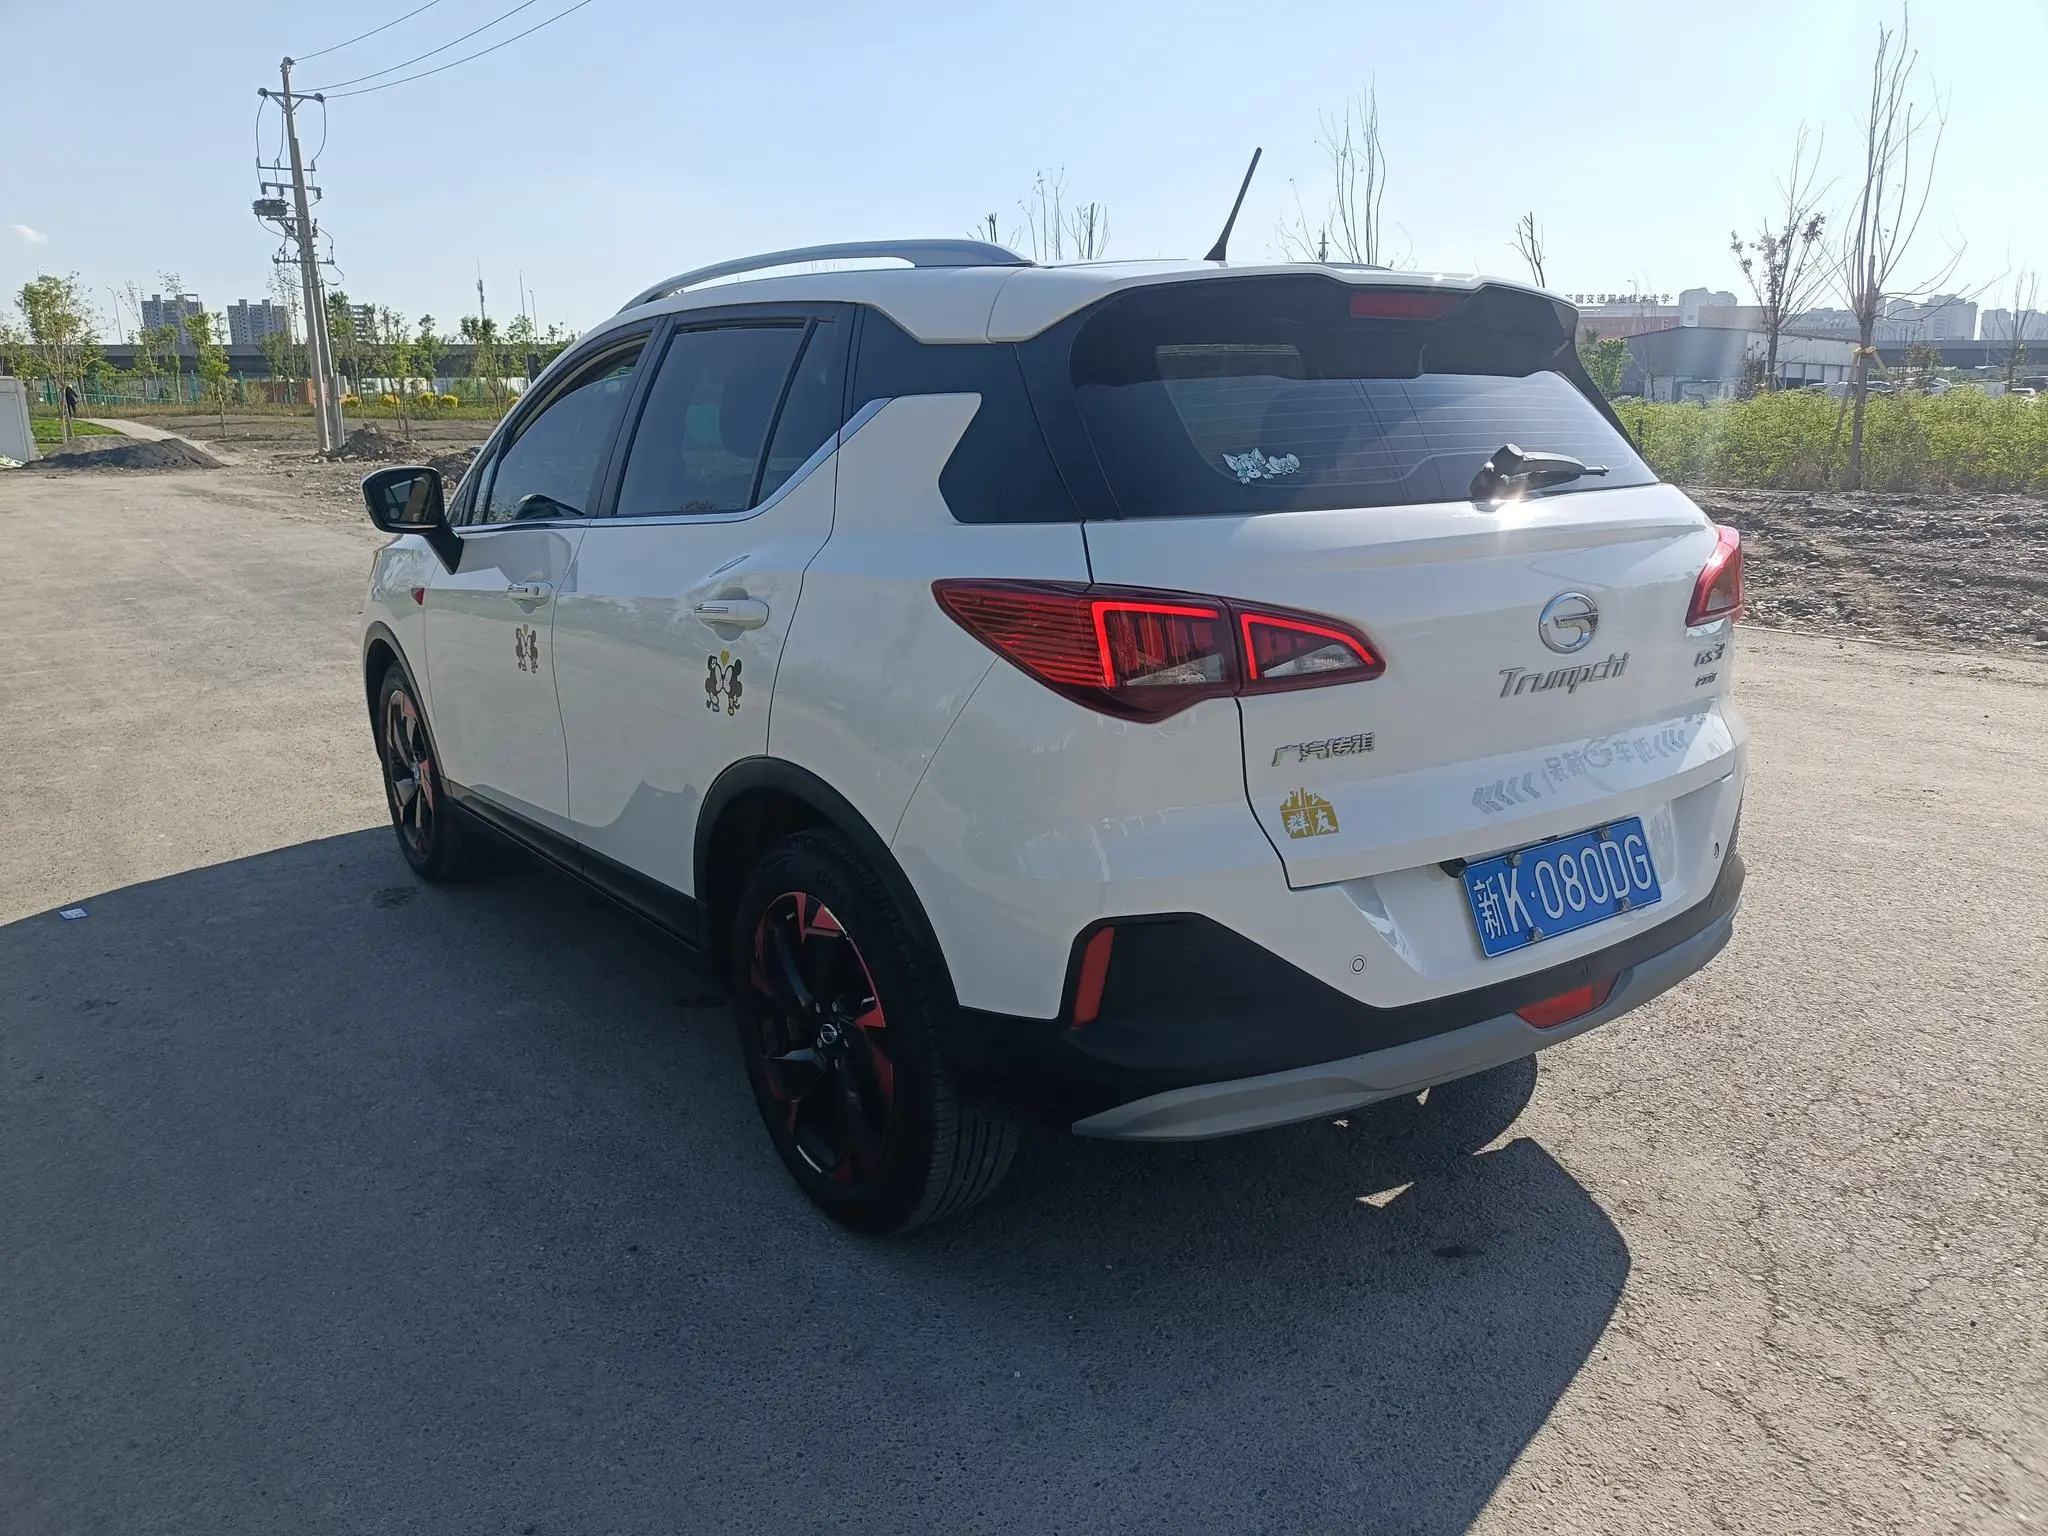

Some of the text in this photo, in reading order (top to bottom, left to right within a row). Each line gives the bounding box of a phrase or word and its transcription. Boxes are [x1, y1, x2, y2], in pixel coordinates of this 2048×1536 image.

[1499, 652, 1631, 699] Trumpchi
[1271, 731, 1375, 767] 广汽传祺
